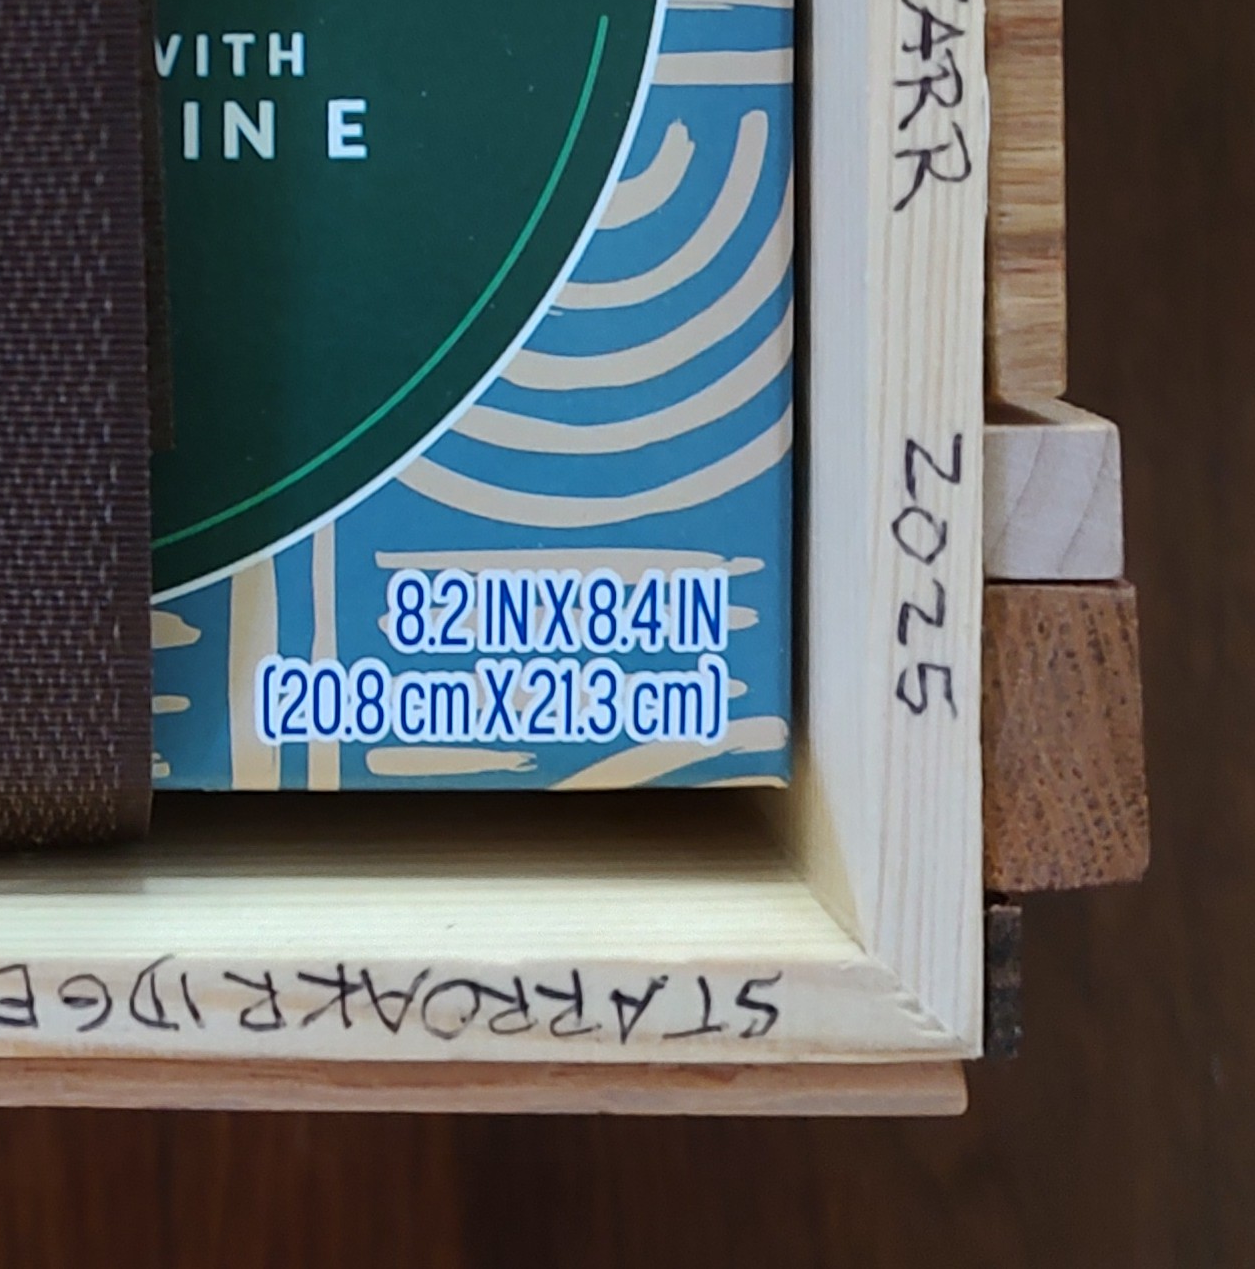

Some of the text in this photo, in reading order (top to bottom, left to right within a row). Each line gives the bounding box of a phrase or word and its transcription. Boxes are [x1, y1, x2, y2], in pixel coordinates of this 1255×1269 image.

[327, 98, 368, 159] E
[395, 578, 722, 648] 8.2 IN X 8.4 IN
[890, 431, 967, 723] 2025
[262, 664, 721, 739] (20.8 cm X 21.3 cm)
